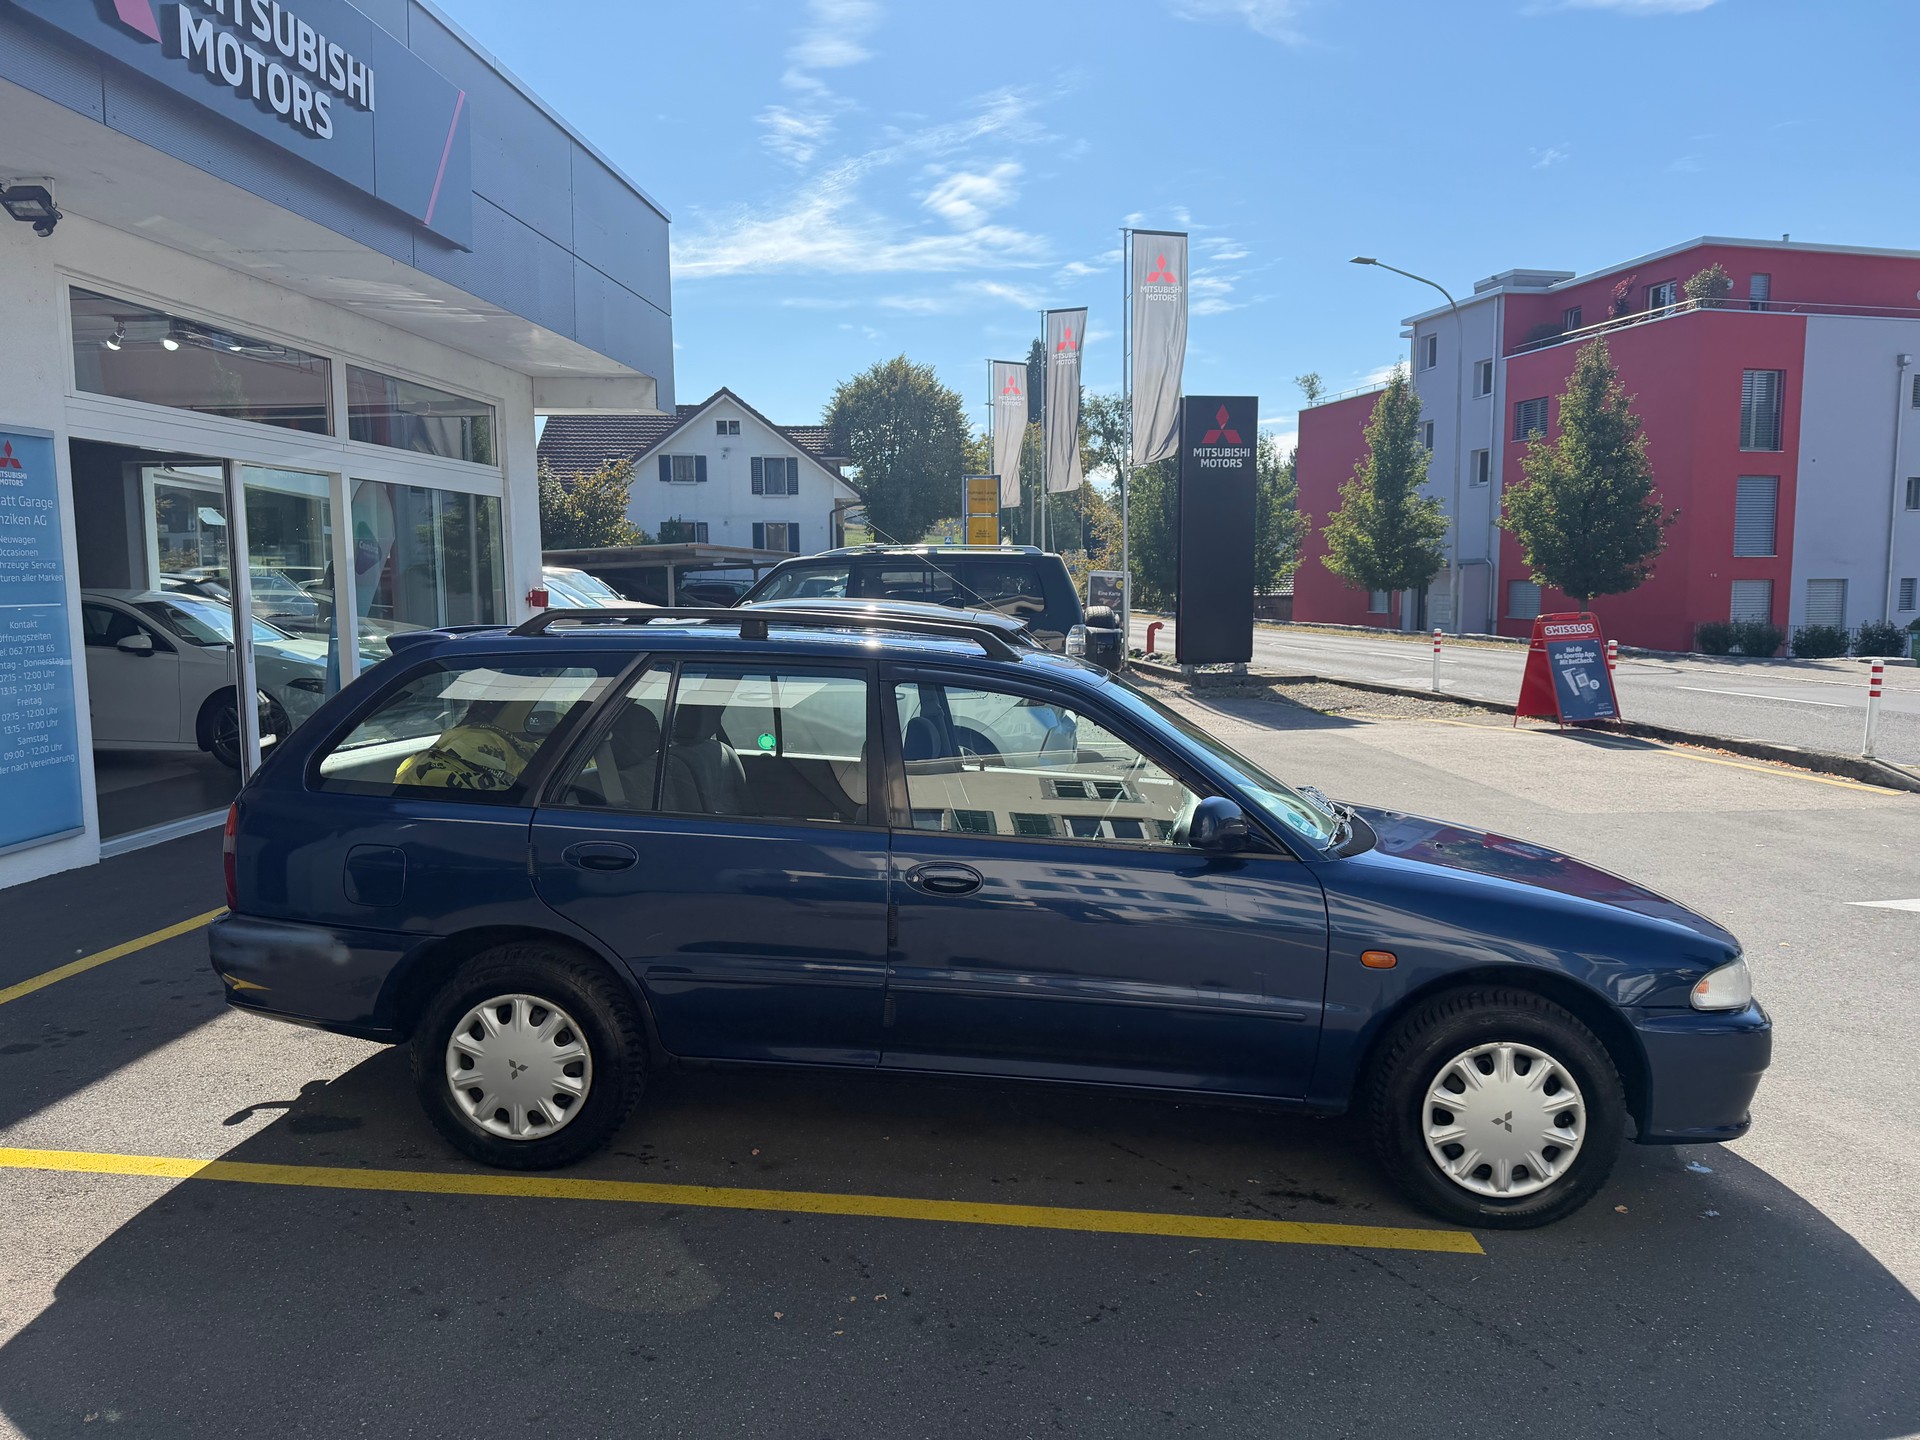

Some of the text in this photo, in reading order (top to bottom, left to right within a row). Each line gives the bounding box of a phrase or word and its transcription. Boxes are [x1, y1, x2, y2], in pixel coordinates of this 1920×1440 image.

[202, 0, 375, 112] SUBISHI
[179, 3, 333, 140] MOTORS
[1140, 285, 1183, 294] MITSUBISHI
[1146, 293, 1177, 301] MOTORS
[1193, 447, 1250, 457] MITSUBISHI
[1200, 458, 1243, 468] MOTORS
[0, 496, 53, 511] att Garage
[0, 514, 47, 526] nziken AG
[0, 561, 57, 571] hrzeuge Service
[22, 574, 37, 582] aller
[38, 574, 64, 582] Marken
[9, 620, 38, 629] Kontakt
[1545, 624, 1594, 635] SWISSLOS
[9, 647, 23, 656] 062
[25, 646, 35, 654] 771
[37, 645, 44, 653] 18
[46, 644, 55, 652] 65
[0, 662, 16, 671] ntag
[24, 658, 64, 668] Donnerstag
[43, 669, 55, 678] Uhr
[43, 682, 55, 691] Uhr
[17, 697, 42, 707] Freitag
[46, 706, 58, 715] Uhr
[46, 719, 58, 728] Uhr
[17, 734, 48, 746] Samstag
[50, 743, 62, 752] Uhr
[11, 762, 28, 773] nach
[30, 753, 75, 768] Vereinbarung
